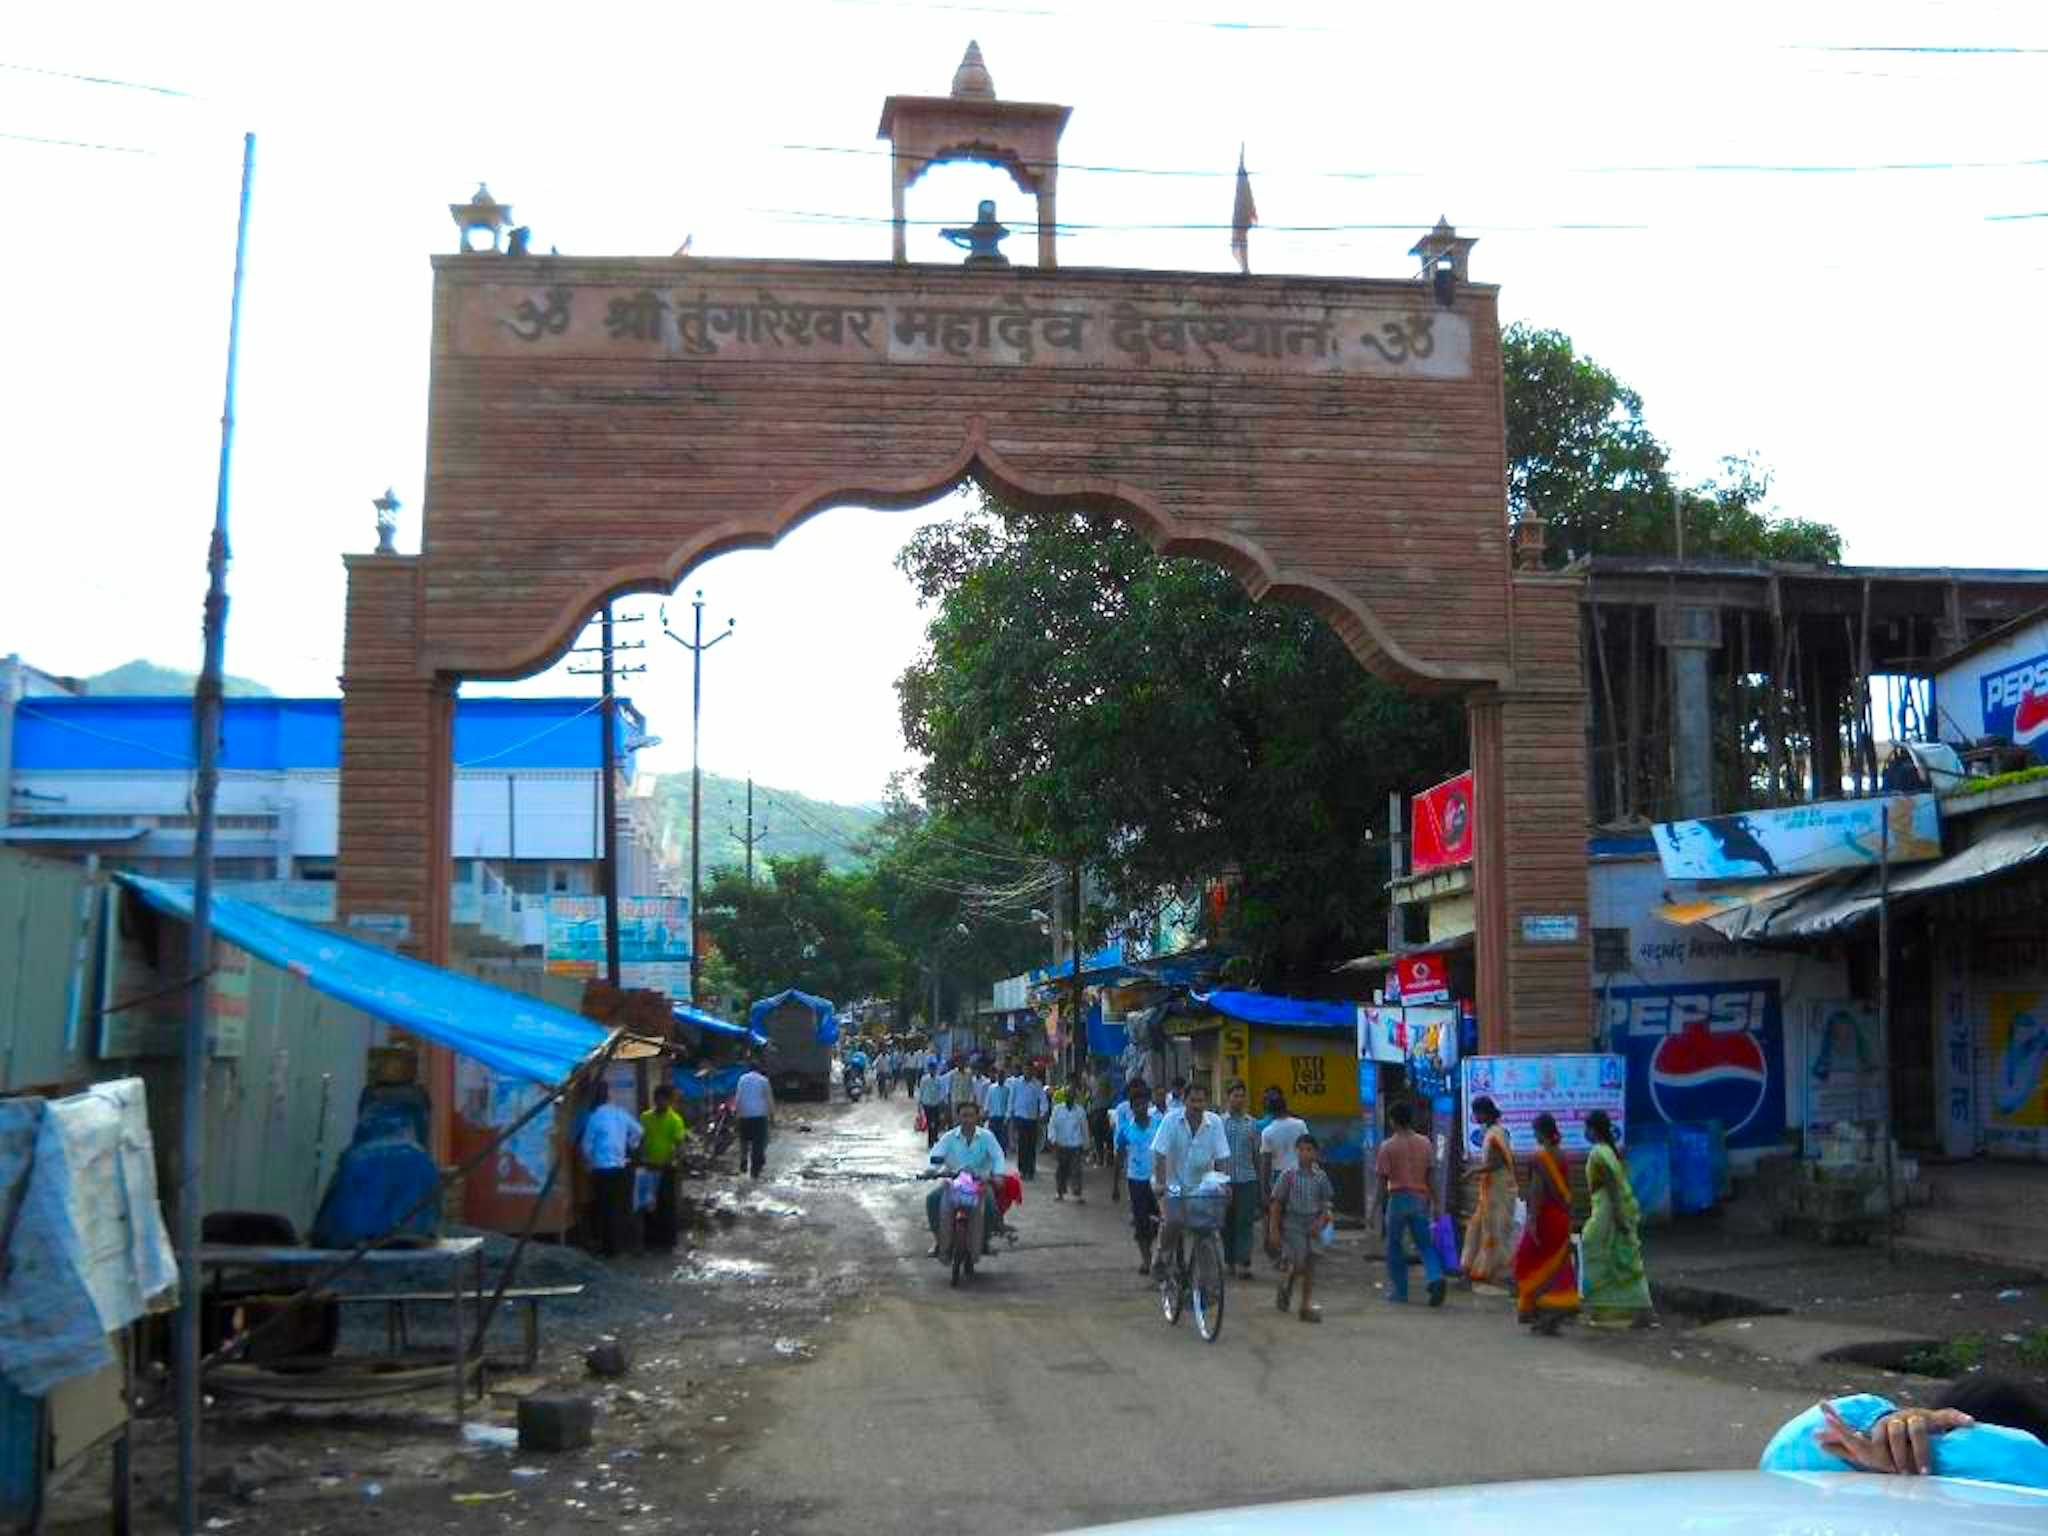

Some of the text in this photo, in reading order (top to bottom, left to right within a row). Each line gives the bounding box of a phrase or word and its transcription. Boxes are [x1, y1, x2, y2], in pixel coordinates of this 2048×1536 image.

[605, 287, 668, 342] श्री
[893, 294, 1093, 360] महादेव
[1986, 660, 2048, 713] PEPS
[1606, 991, 1766, 1037] PEPSI
[1223, 1029, 1245, 1077] ST
